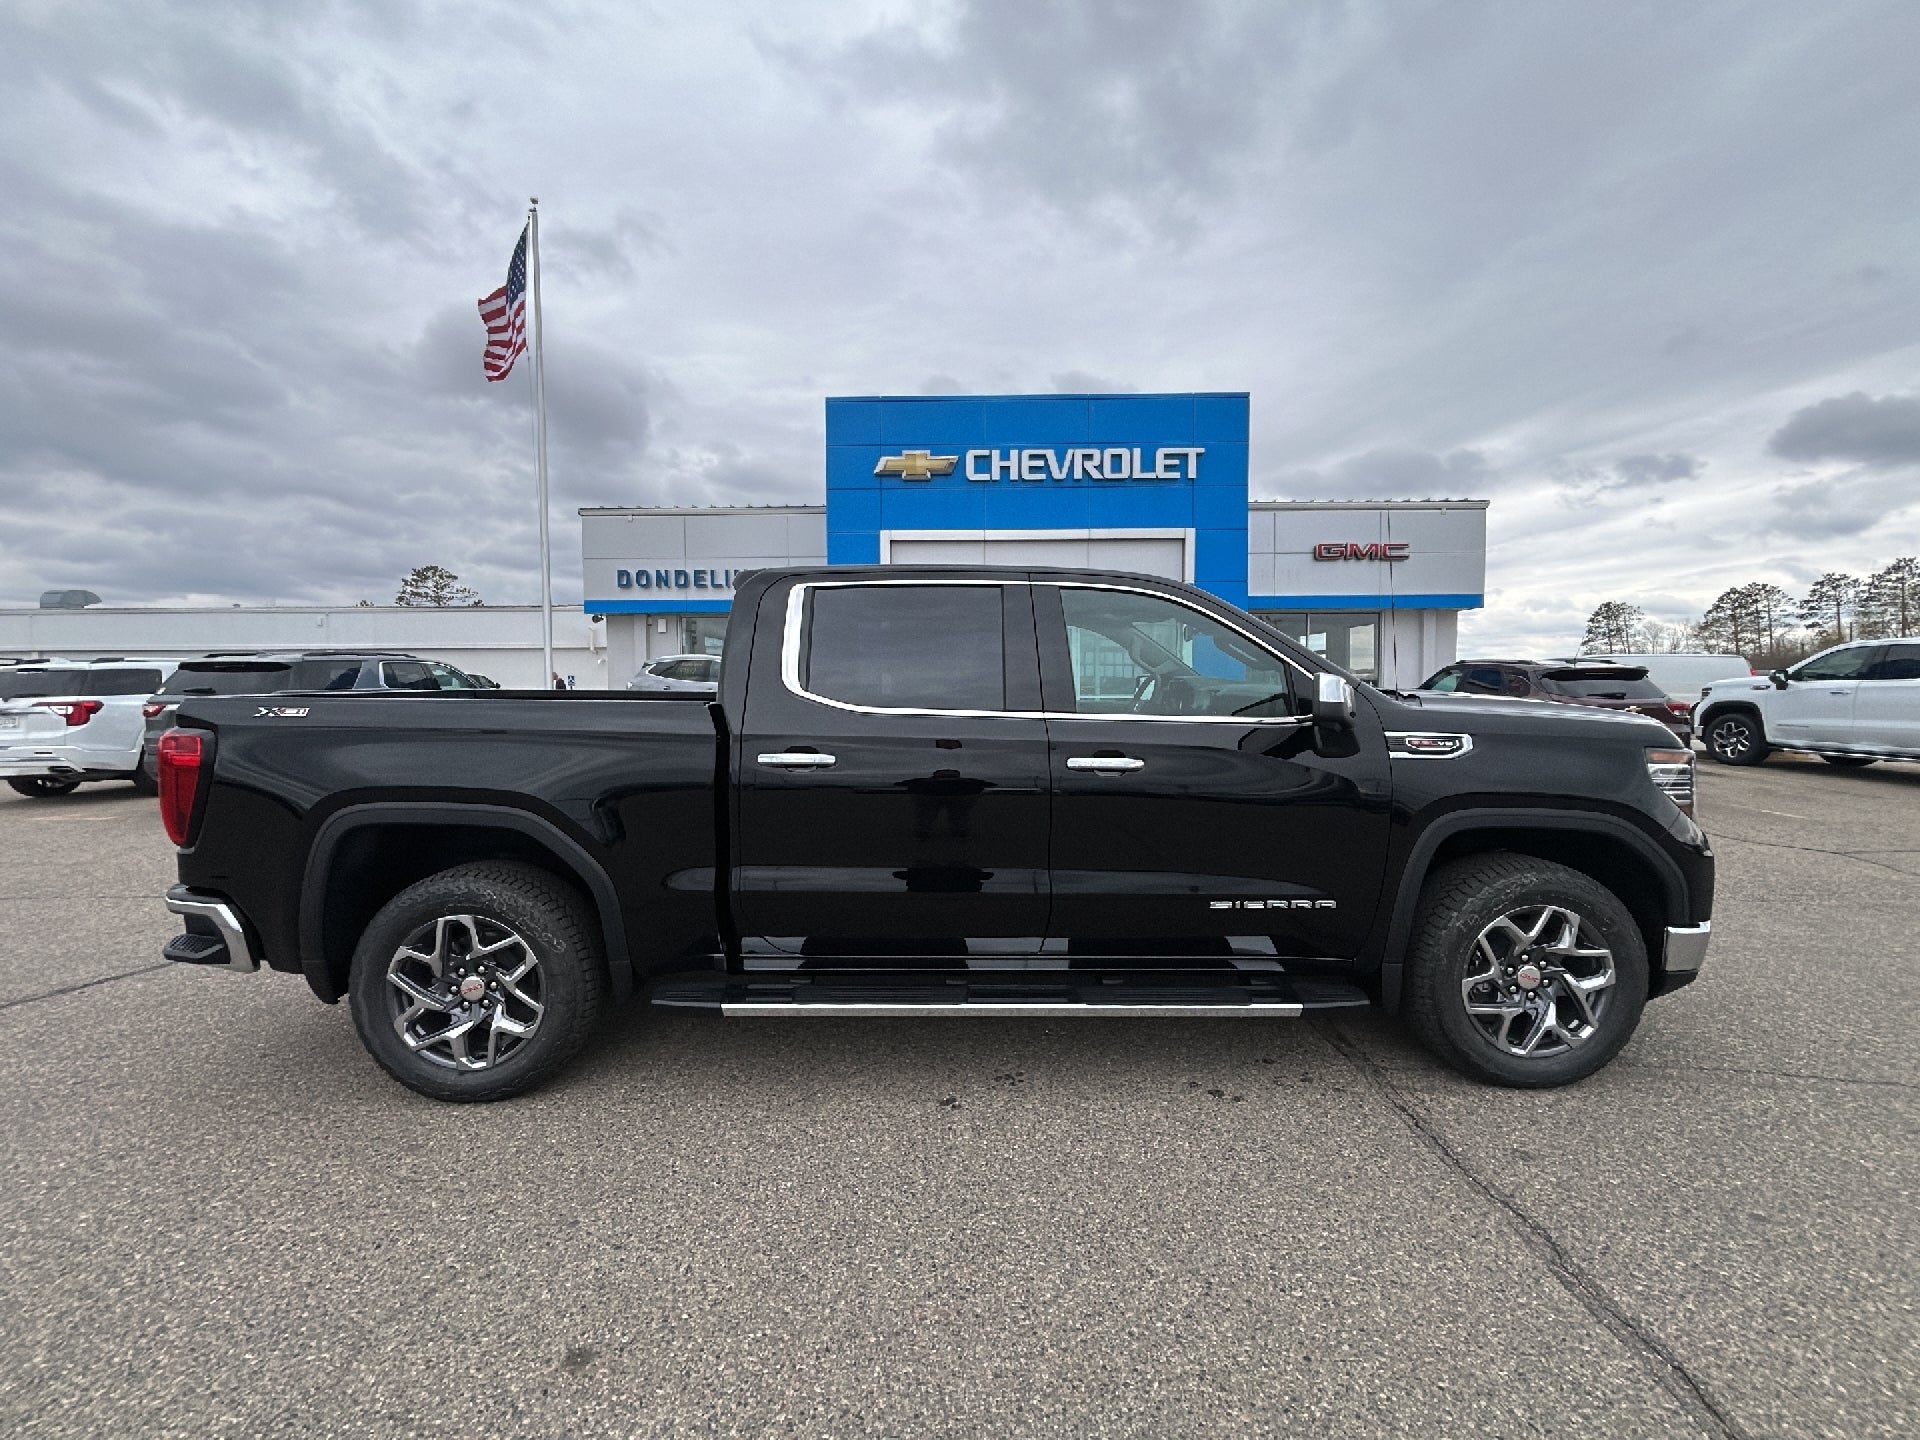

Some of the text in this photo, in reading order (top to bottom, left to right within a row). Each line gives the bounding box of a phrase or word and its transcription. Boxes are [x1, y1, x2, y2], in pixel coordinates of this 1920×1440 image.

[966, 447, 1205, 481] CHEVROLET
[1315, 542, 1409, 560] GMC
[616, 569, 740, 589] DONDELI
[1209, 900, 1337, 909] SIERRA
